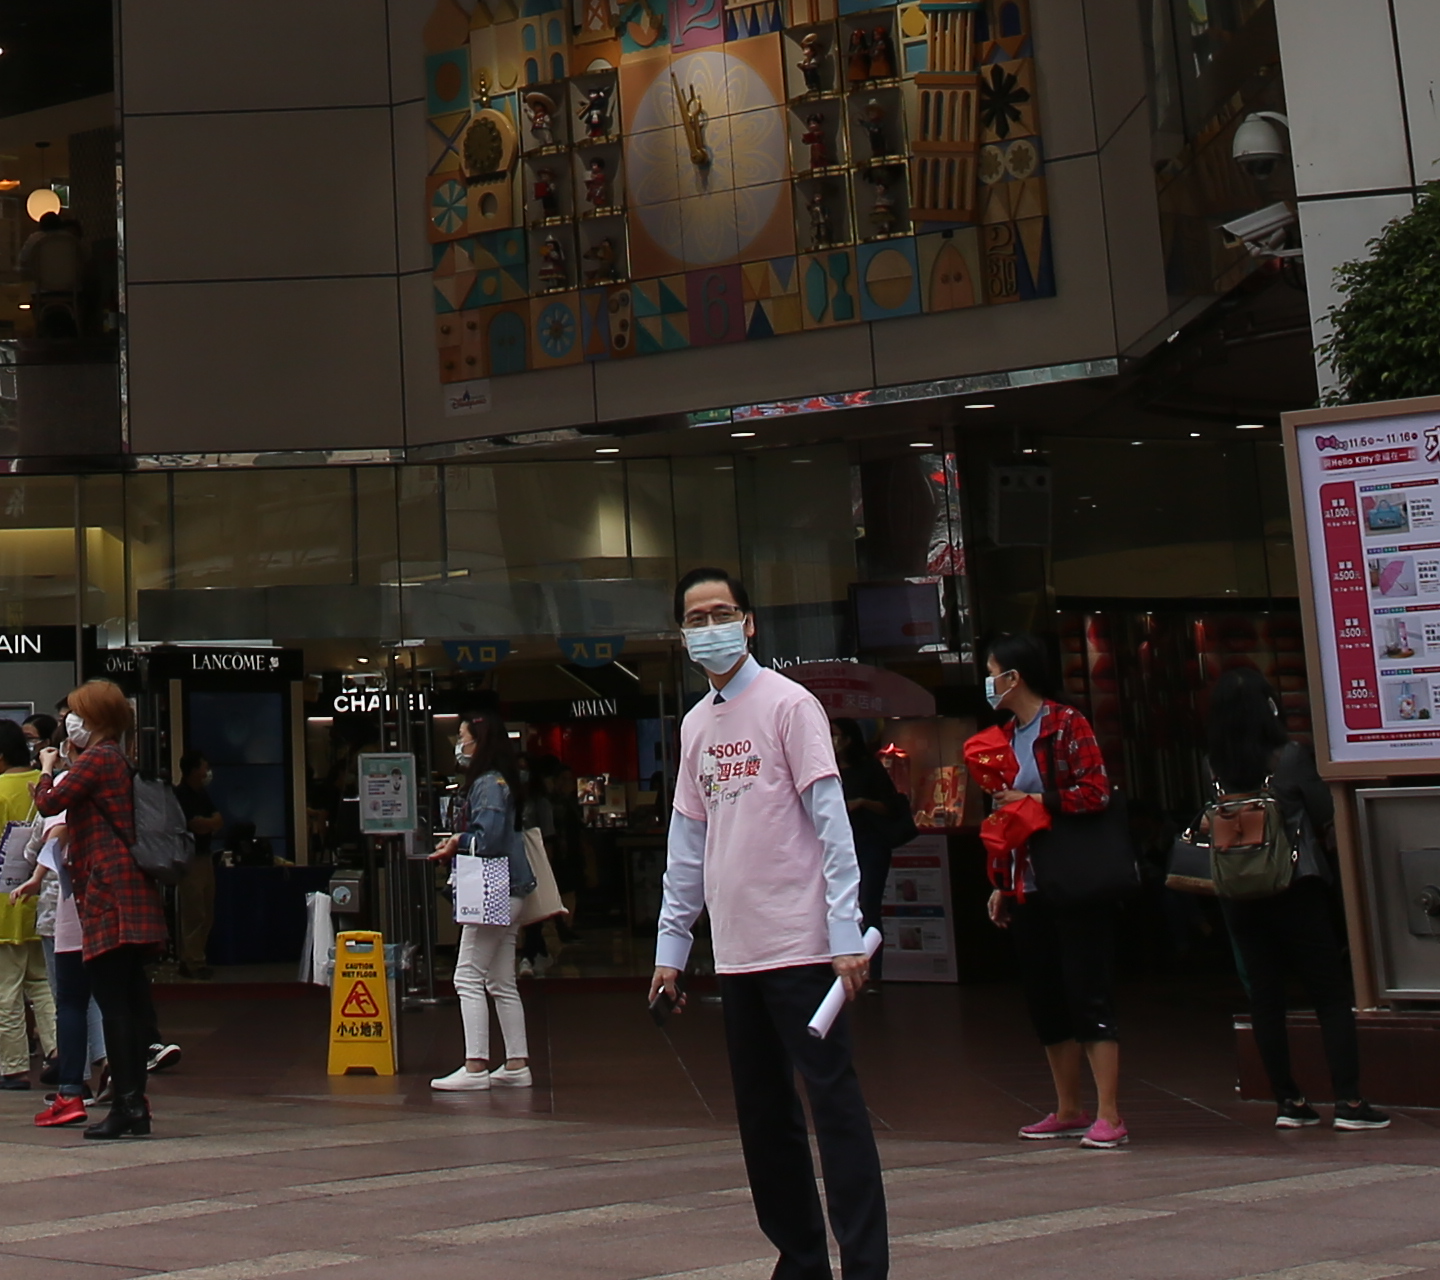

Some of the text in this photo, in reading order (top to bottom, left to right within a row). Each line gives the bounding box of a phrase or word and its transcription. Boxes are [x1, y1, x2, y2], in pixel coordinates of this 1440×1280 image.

[700, 271, 731, 341] 6
[191, 651, 266, 671] LANCÔME
[570, 697, 618, 719] ARMANI
[716, 739, 752, 759] SOGO
[717, 757, 762, 782] 週年慶
[341, 970, 378, 978] WET FLOOR
[345, 962, 374, 970] CAUTION
[336, 1021, 384, 1038] 小心地滑
